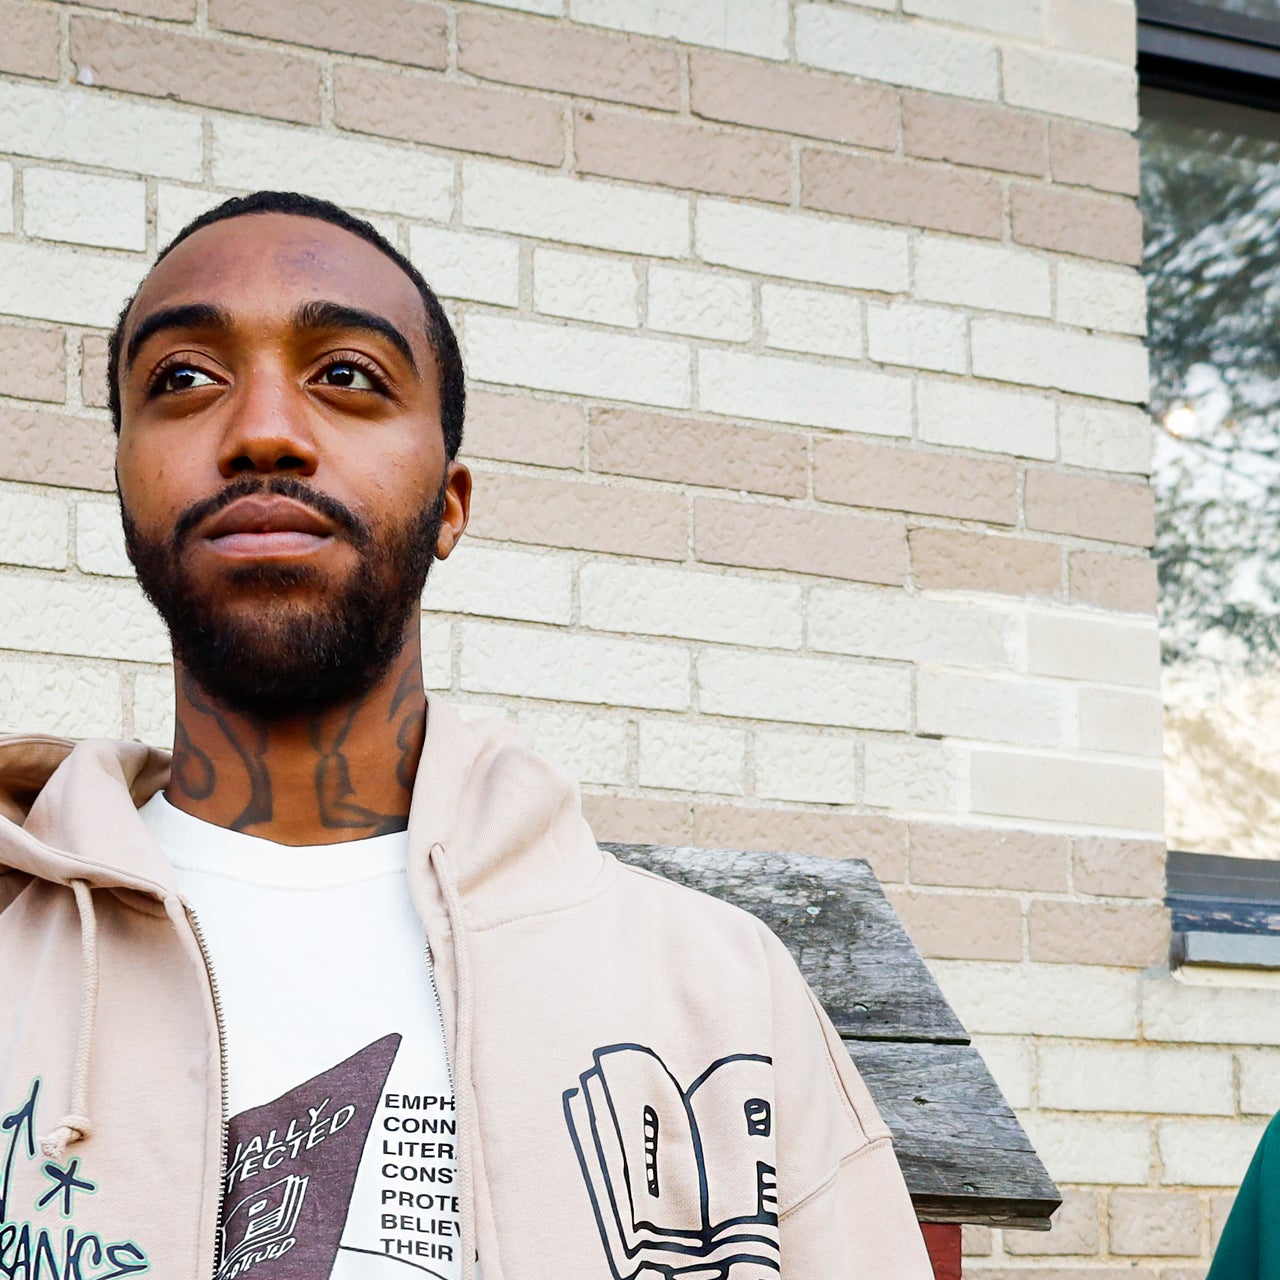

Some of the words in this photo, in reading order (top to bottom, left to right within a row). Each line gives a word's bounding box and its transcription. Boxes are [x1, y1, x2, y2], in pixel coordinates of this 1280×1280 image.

[382, 1116, 457, 1136] CONN
[382, 1139, 458, 1161] LITER
[381, 1163, 458, 1185] CONS
[378, 1238, 454, 1263] THEIR
